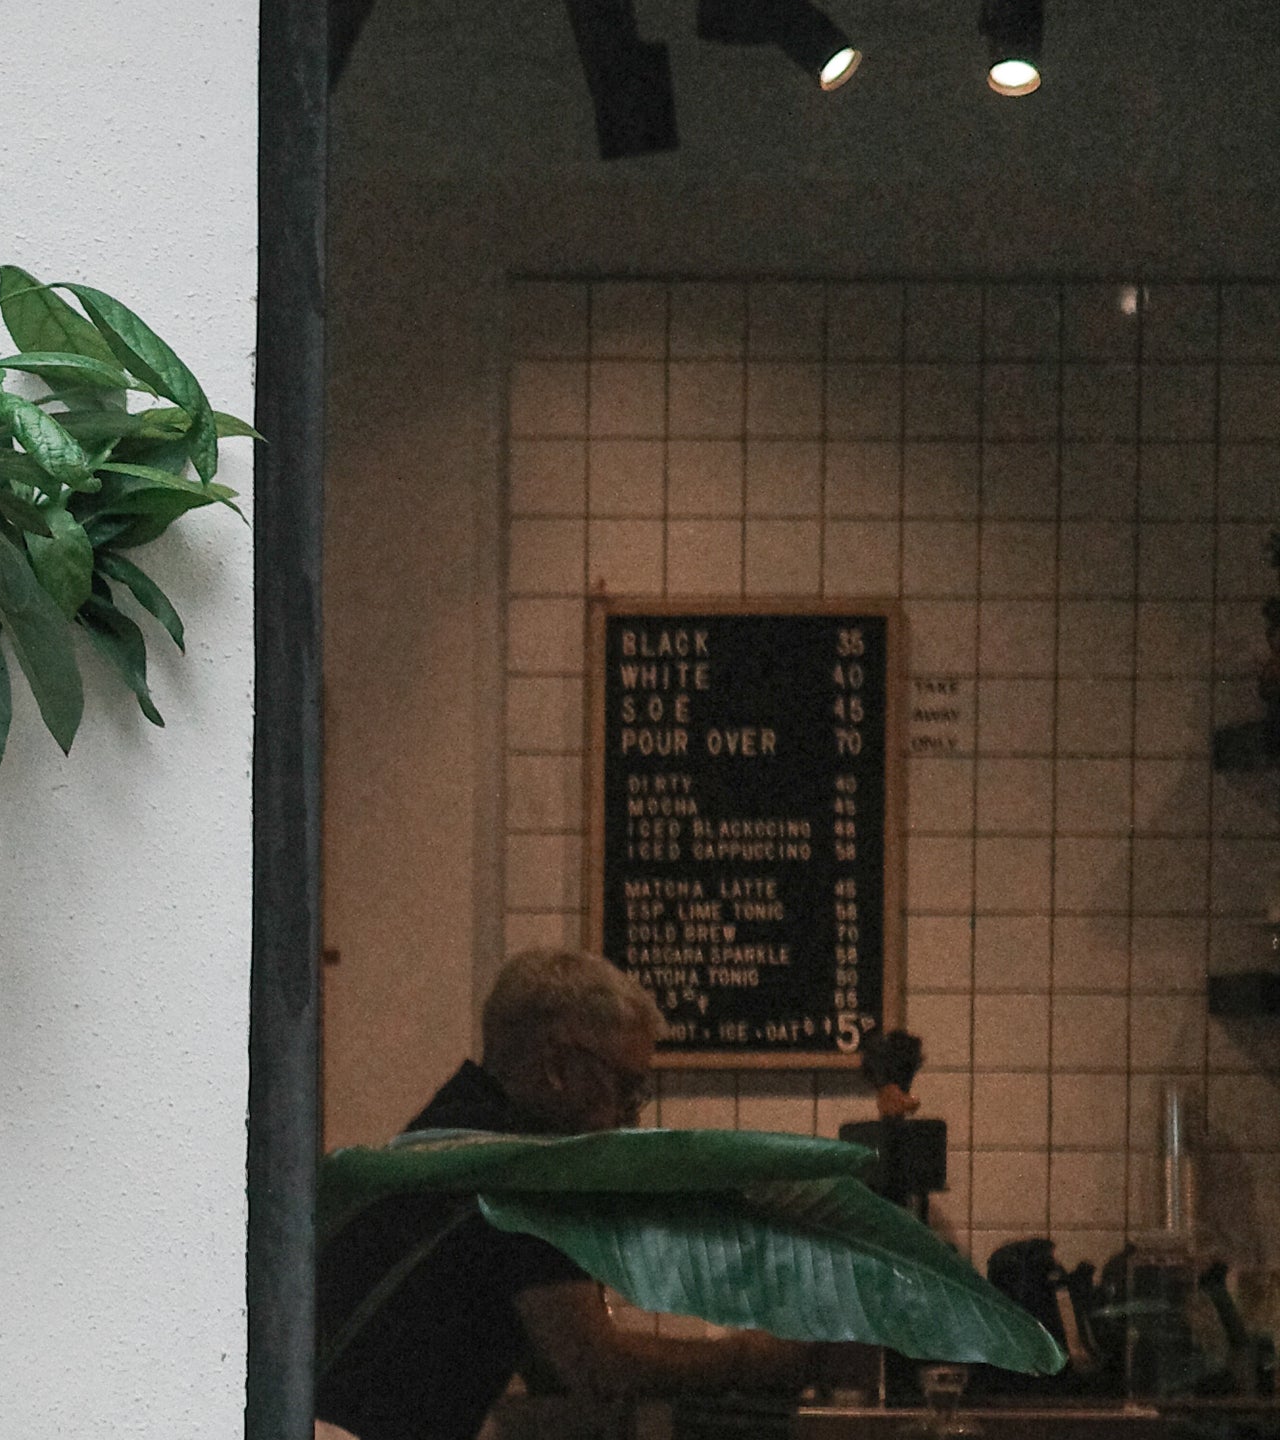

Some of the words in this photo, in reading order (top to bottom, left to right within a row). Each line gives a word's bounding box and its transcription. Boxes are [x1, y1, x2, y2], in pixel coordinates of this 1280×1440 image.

[622, 630, 708, 658] BLACK
[621, 662, 710, 690] WHITE
[834, 664, 864, 689] 40
[622, 728, 688, 756] POUR
[707, 727, 776, 756] OVER
[836, 728, 861, 756] 70
[628, 773, 691, 795] DIRTY
[628, 797, 697, 817] MOCHA
[629, 819, 681, 839] ICED
[629, 841, 681, 862] ICED
[693, 841, 811, 862] CAPPUCCINO
[625, 880, 703, 899] MATCHA
[720, 879, 777, 900] LATTE
[628, 902, 664, 921] ESP
[678, 902, 722, 921] LIME
[734, 902, 784, 921] TONIC
[628, 924, 678, 943] COLD
[684, 924, 736, 943] BREW
[711, 946, 790, 966] SPARKLE
[626, 968, 699, 987] MATCHA
[708, 967, 759, 987] TONIC
